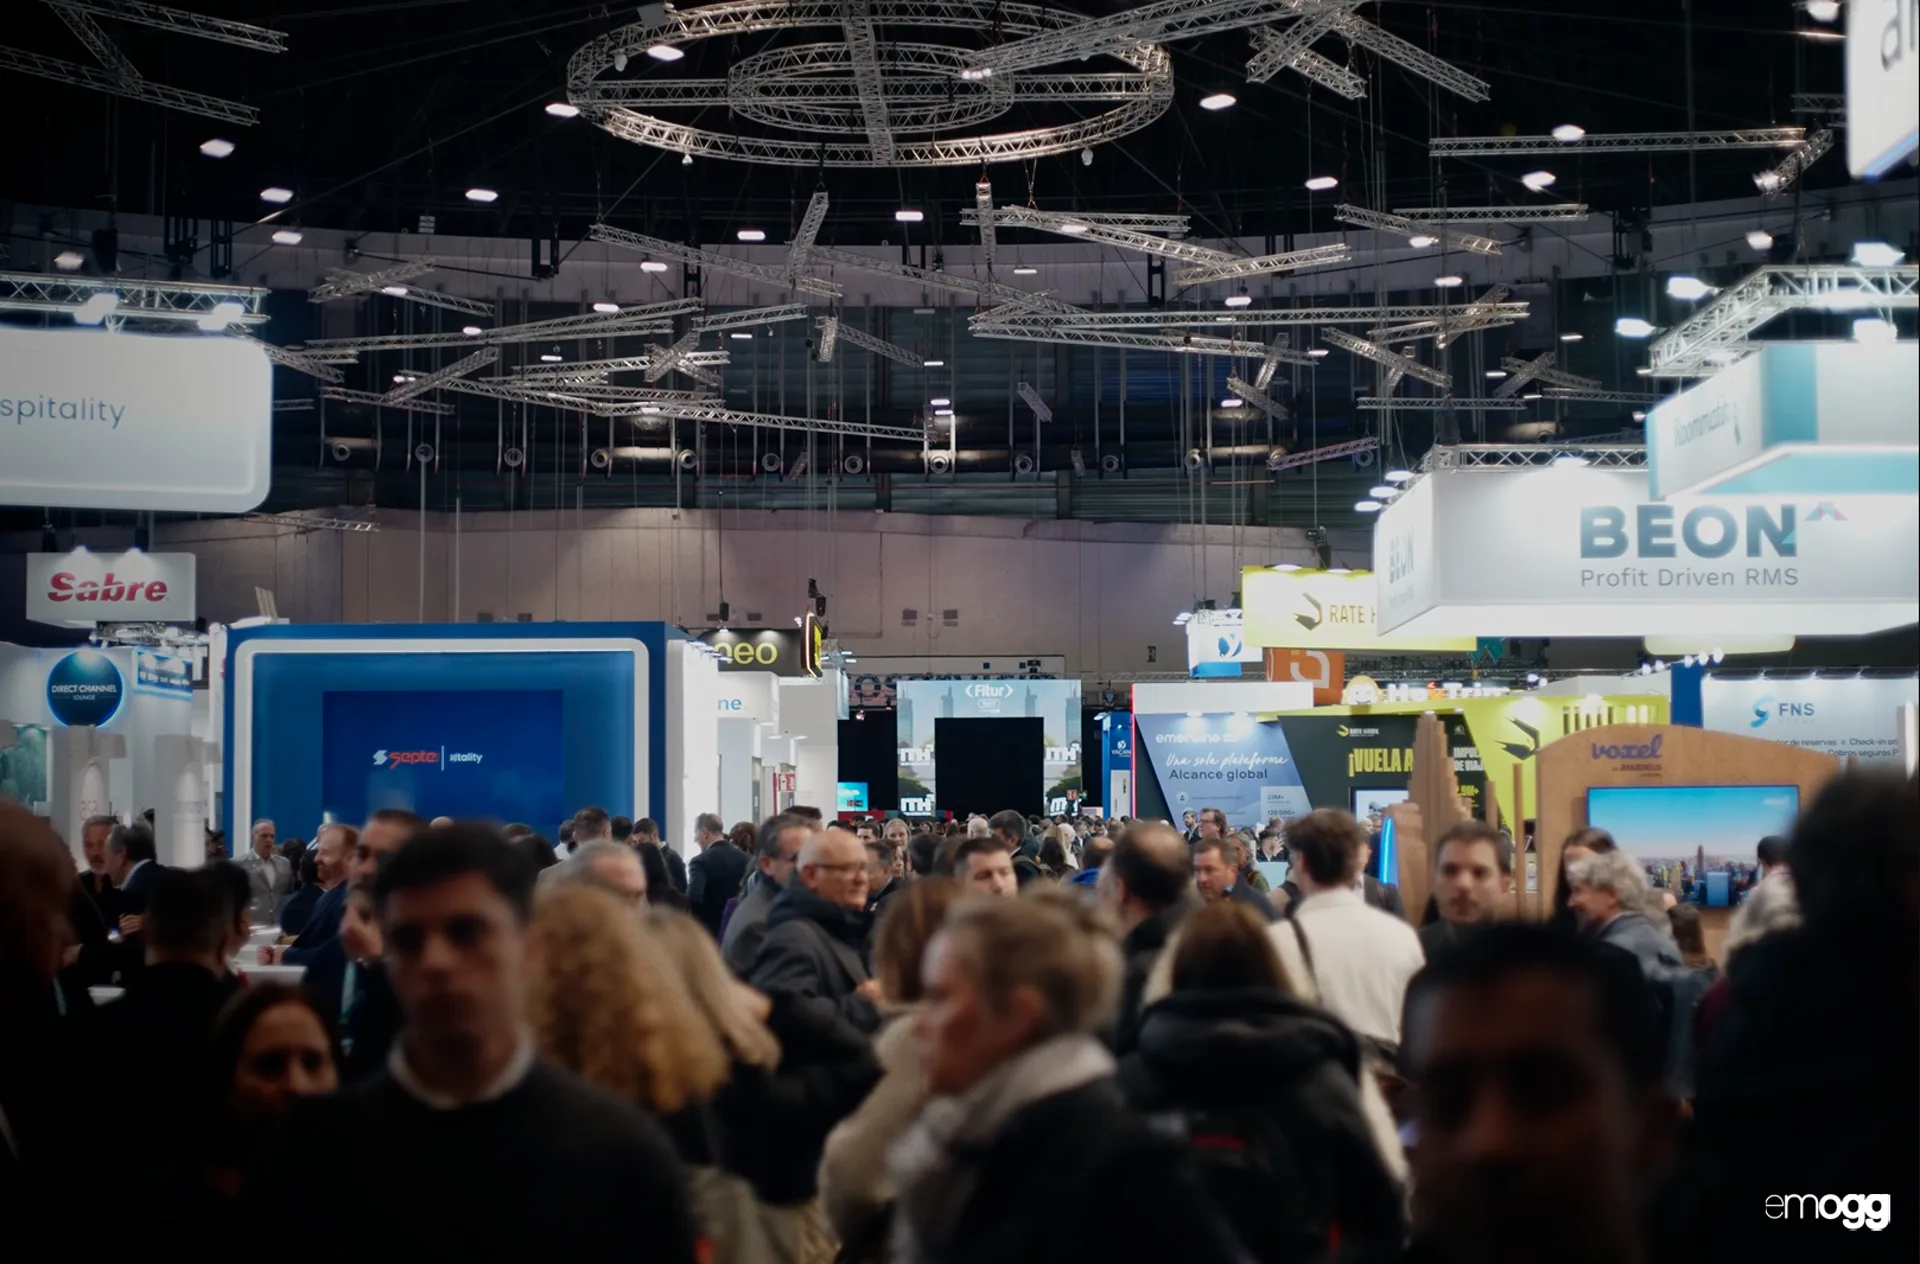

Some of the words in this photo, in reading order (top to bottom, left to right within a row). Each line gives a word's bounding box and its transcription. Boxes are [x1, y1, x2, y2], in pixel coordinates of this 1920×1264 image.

[0, 394, 126, 429] spitality
[1580, 503, 1798, 559] BEON
[1580, 567, 1648, 588] Profit
[1658, 567, 1734, 587] Driven
[1746, 567, 1798, 586] RMS
[47, 572, 168, 602] Sabre
[1329, 605, 1365, 623] RATE
[52, 684, 78, 693] DIRECT
[79, 685, 117, 693] CHANNEL
[1779, 702, 1815, 717] FNS
[1849, 738, 1886, 746] Check-in
[1166, 753, 1191, 767] Una
[1169, 769, 1223, 780] Alcance
[1226, 769, 1268, 782] global
